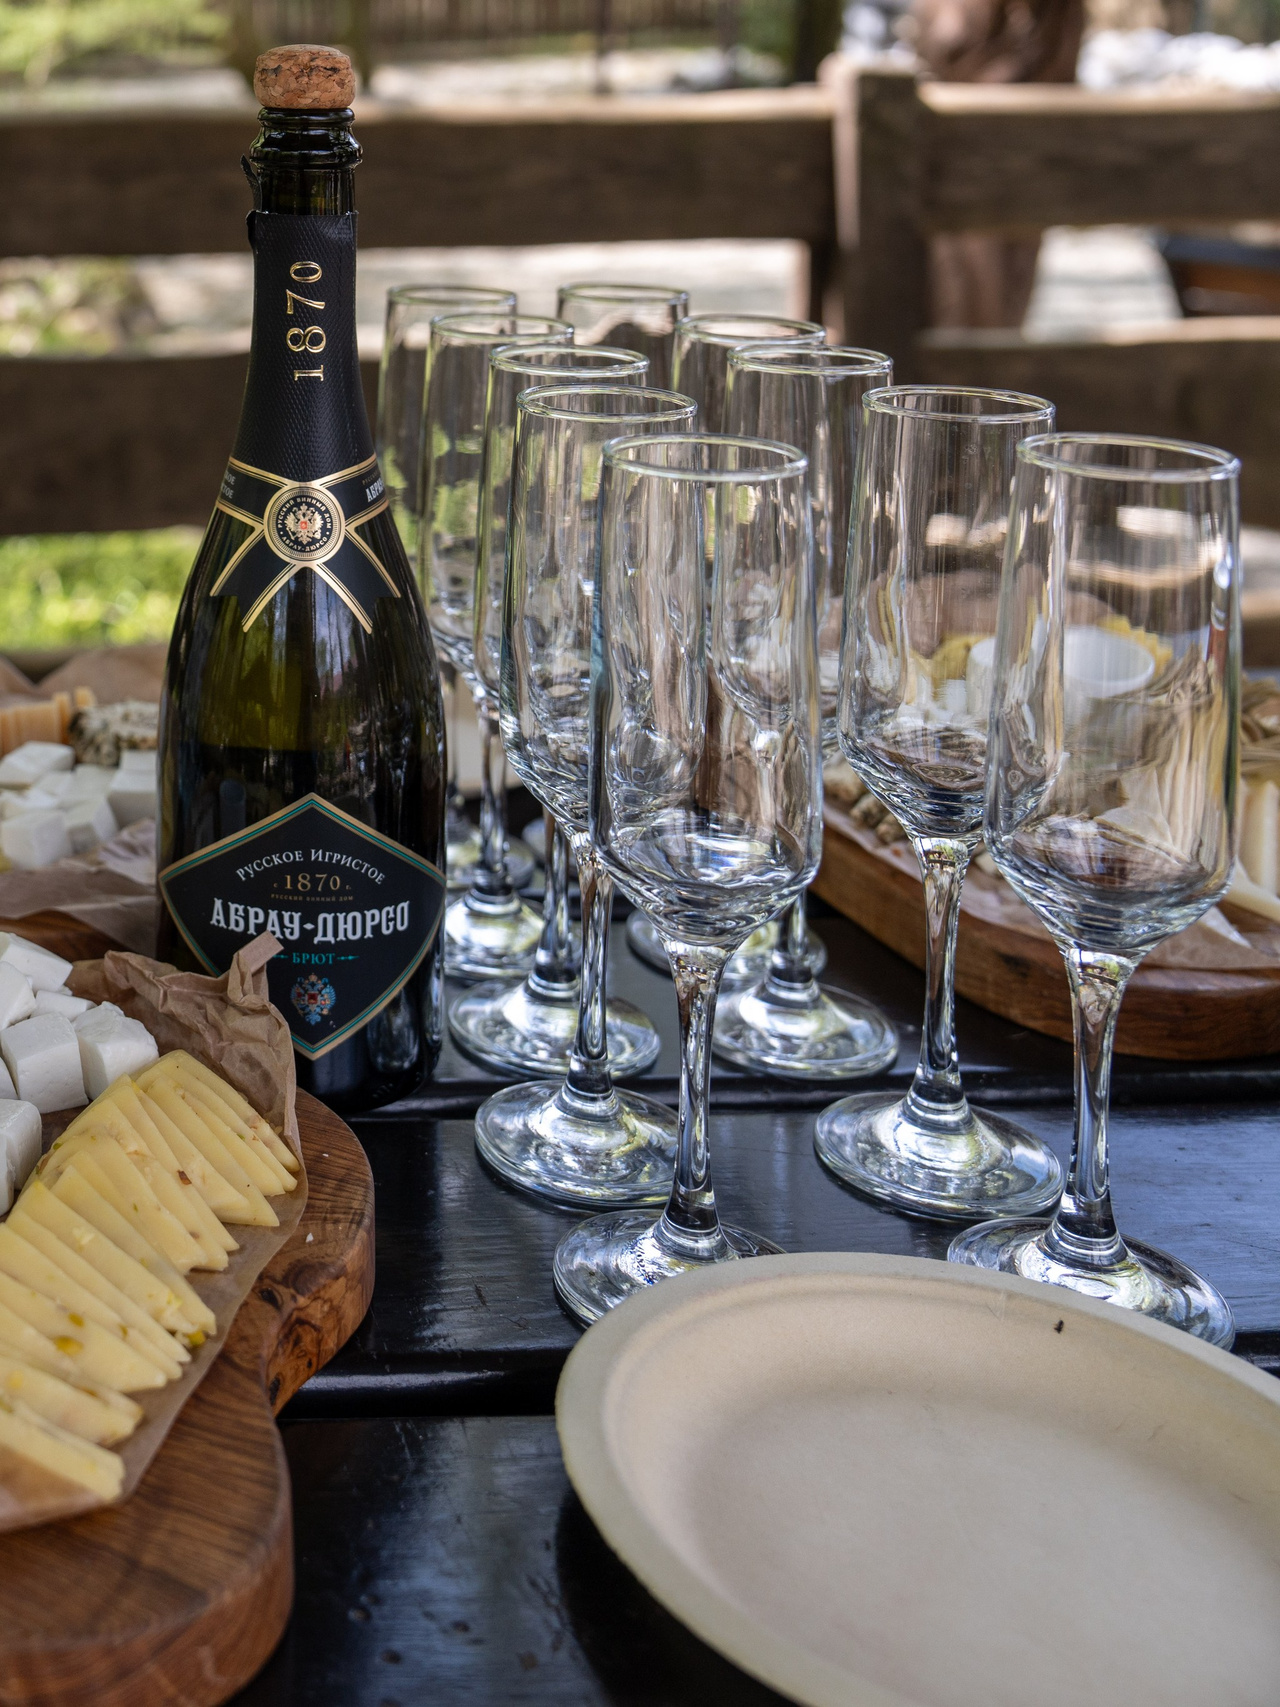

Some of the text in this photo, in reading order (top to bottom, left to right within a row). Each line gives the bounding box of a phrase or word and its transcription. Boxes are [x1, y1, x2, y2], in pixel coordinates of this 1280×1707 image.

[286, 260, 326, 382] 1870
[284, 872, 341, 892] 1870
[210, 897, 411, 945] АБРАУ-ДЮРСО
[292, 952, 336, 966] БРЮТ
